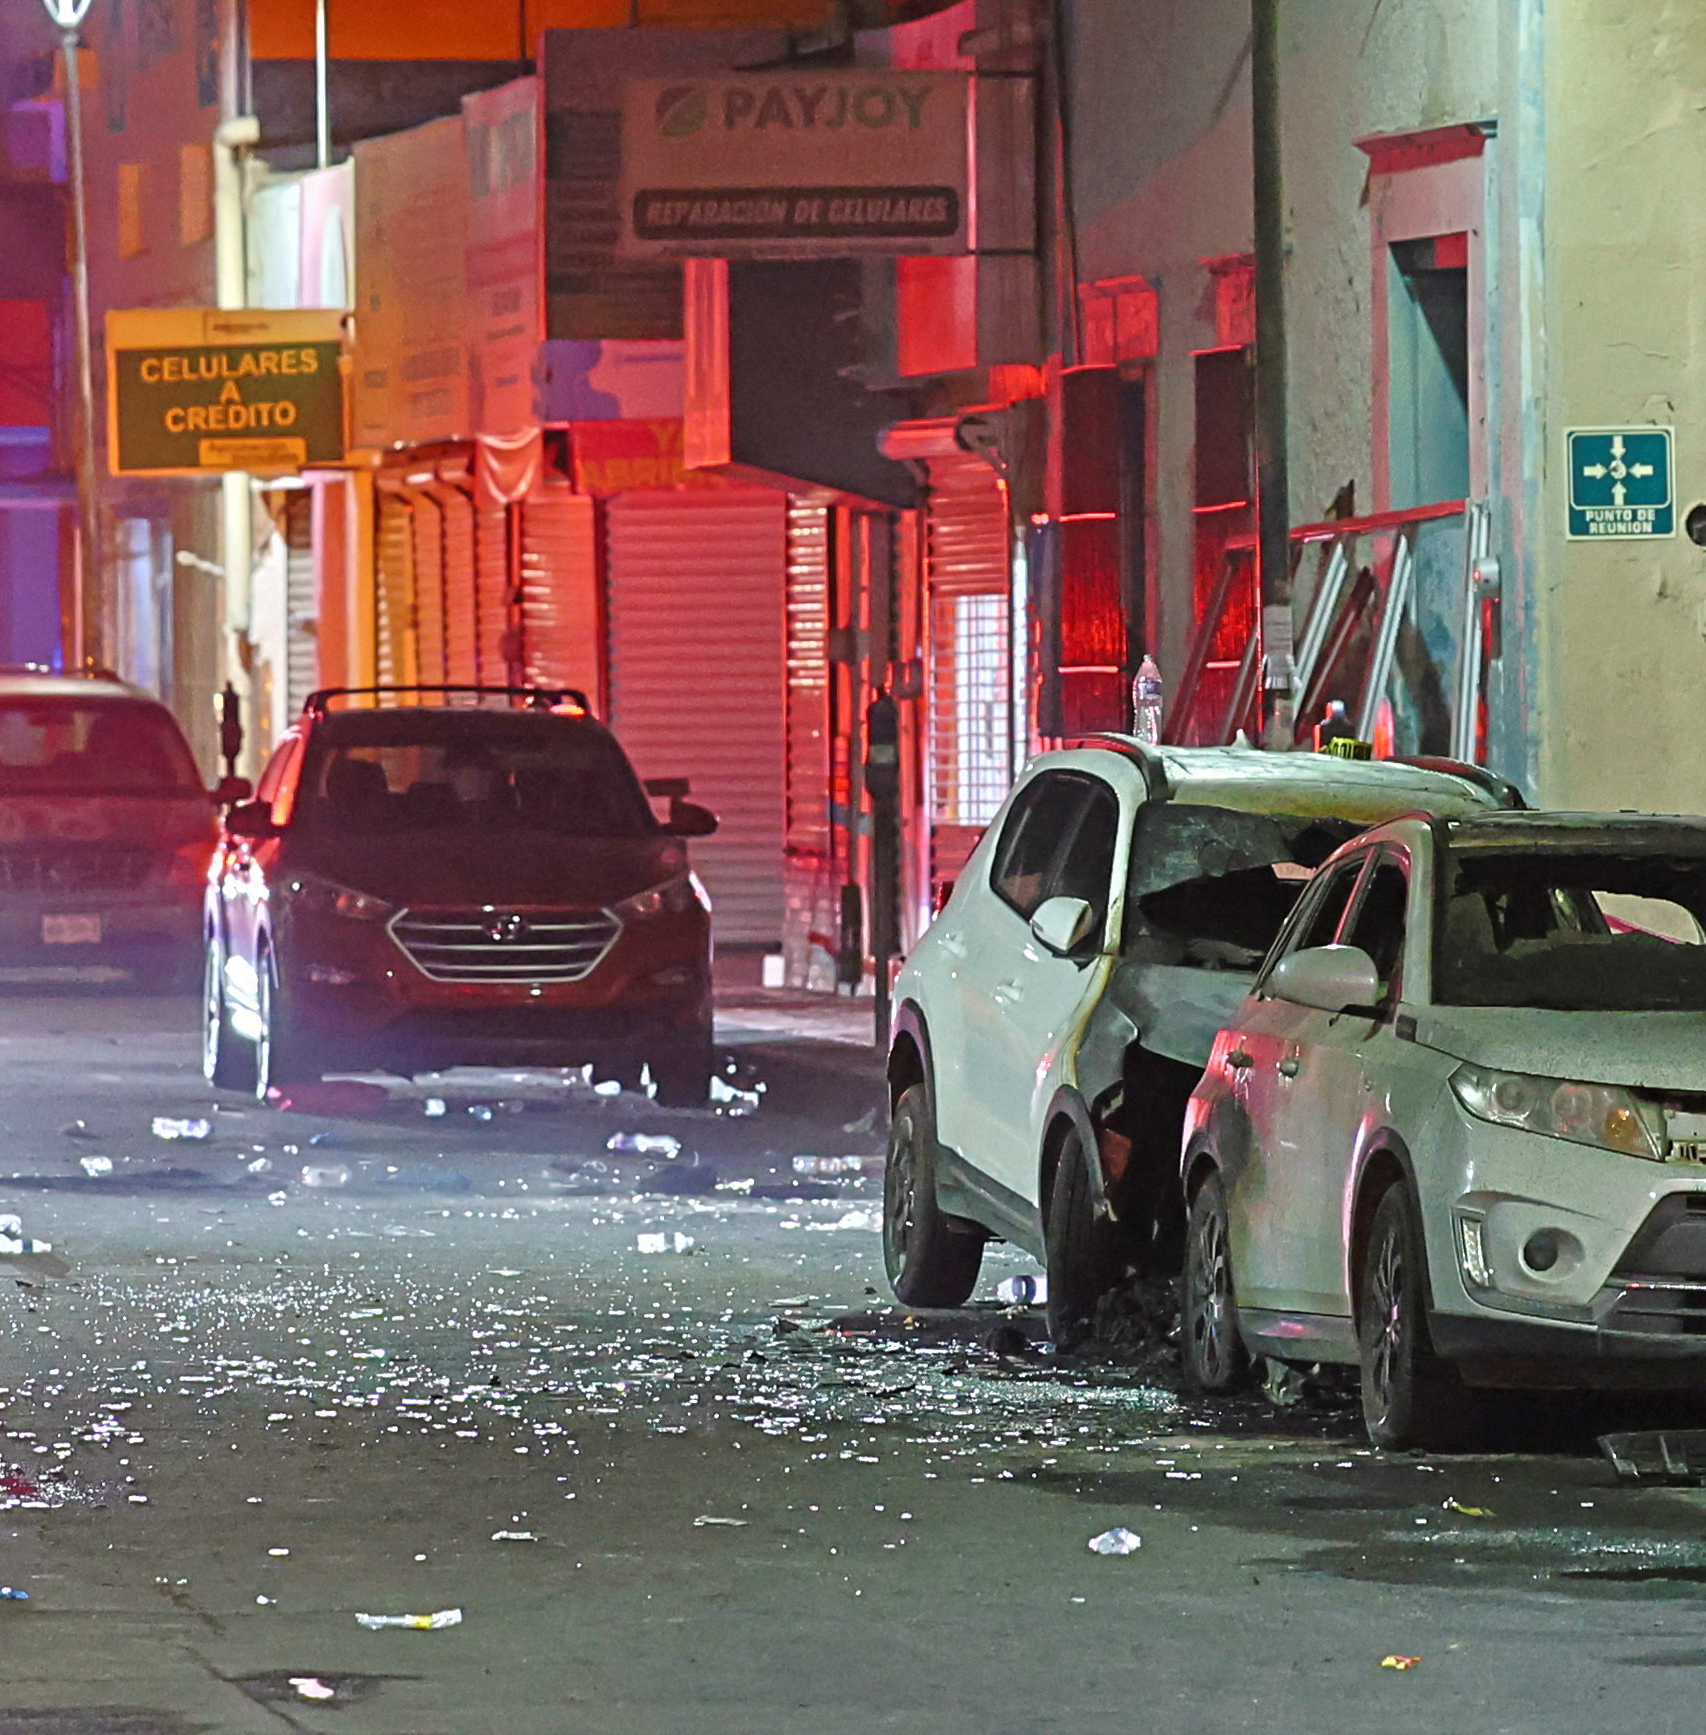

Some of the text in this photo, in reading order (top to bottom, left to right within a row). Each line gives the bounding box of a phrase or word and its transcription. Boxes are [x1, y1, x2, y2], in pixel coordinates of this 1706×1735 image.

[724, 86, 931, 129] PAYJOY
[794, 198, 824, 225] DE
[828, 196, 949, 223] CELULARES
[141, 348, 319, 382] CELULARES
[220, 380, 241, 403] A
[1585, 508, 1656, 522] PUNTO DE
